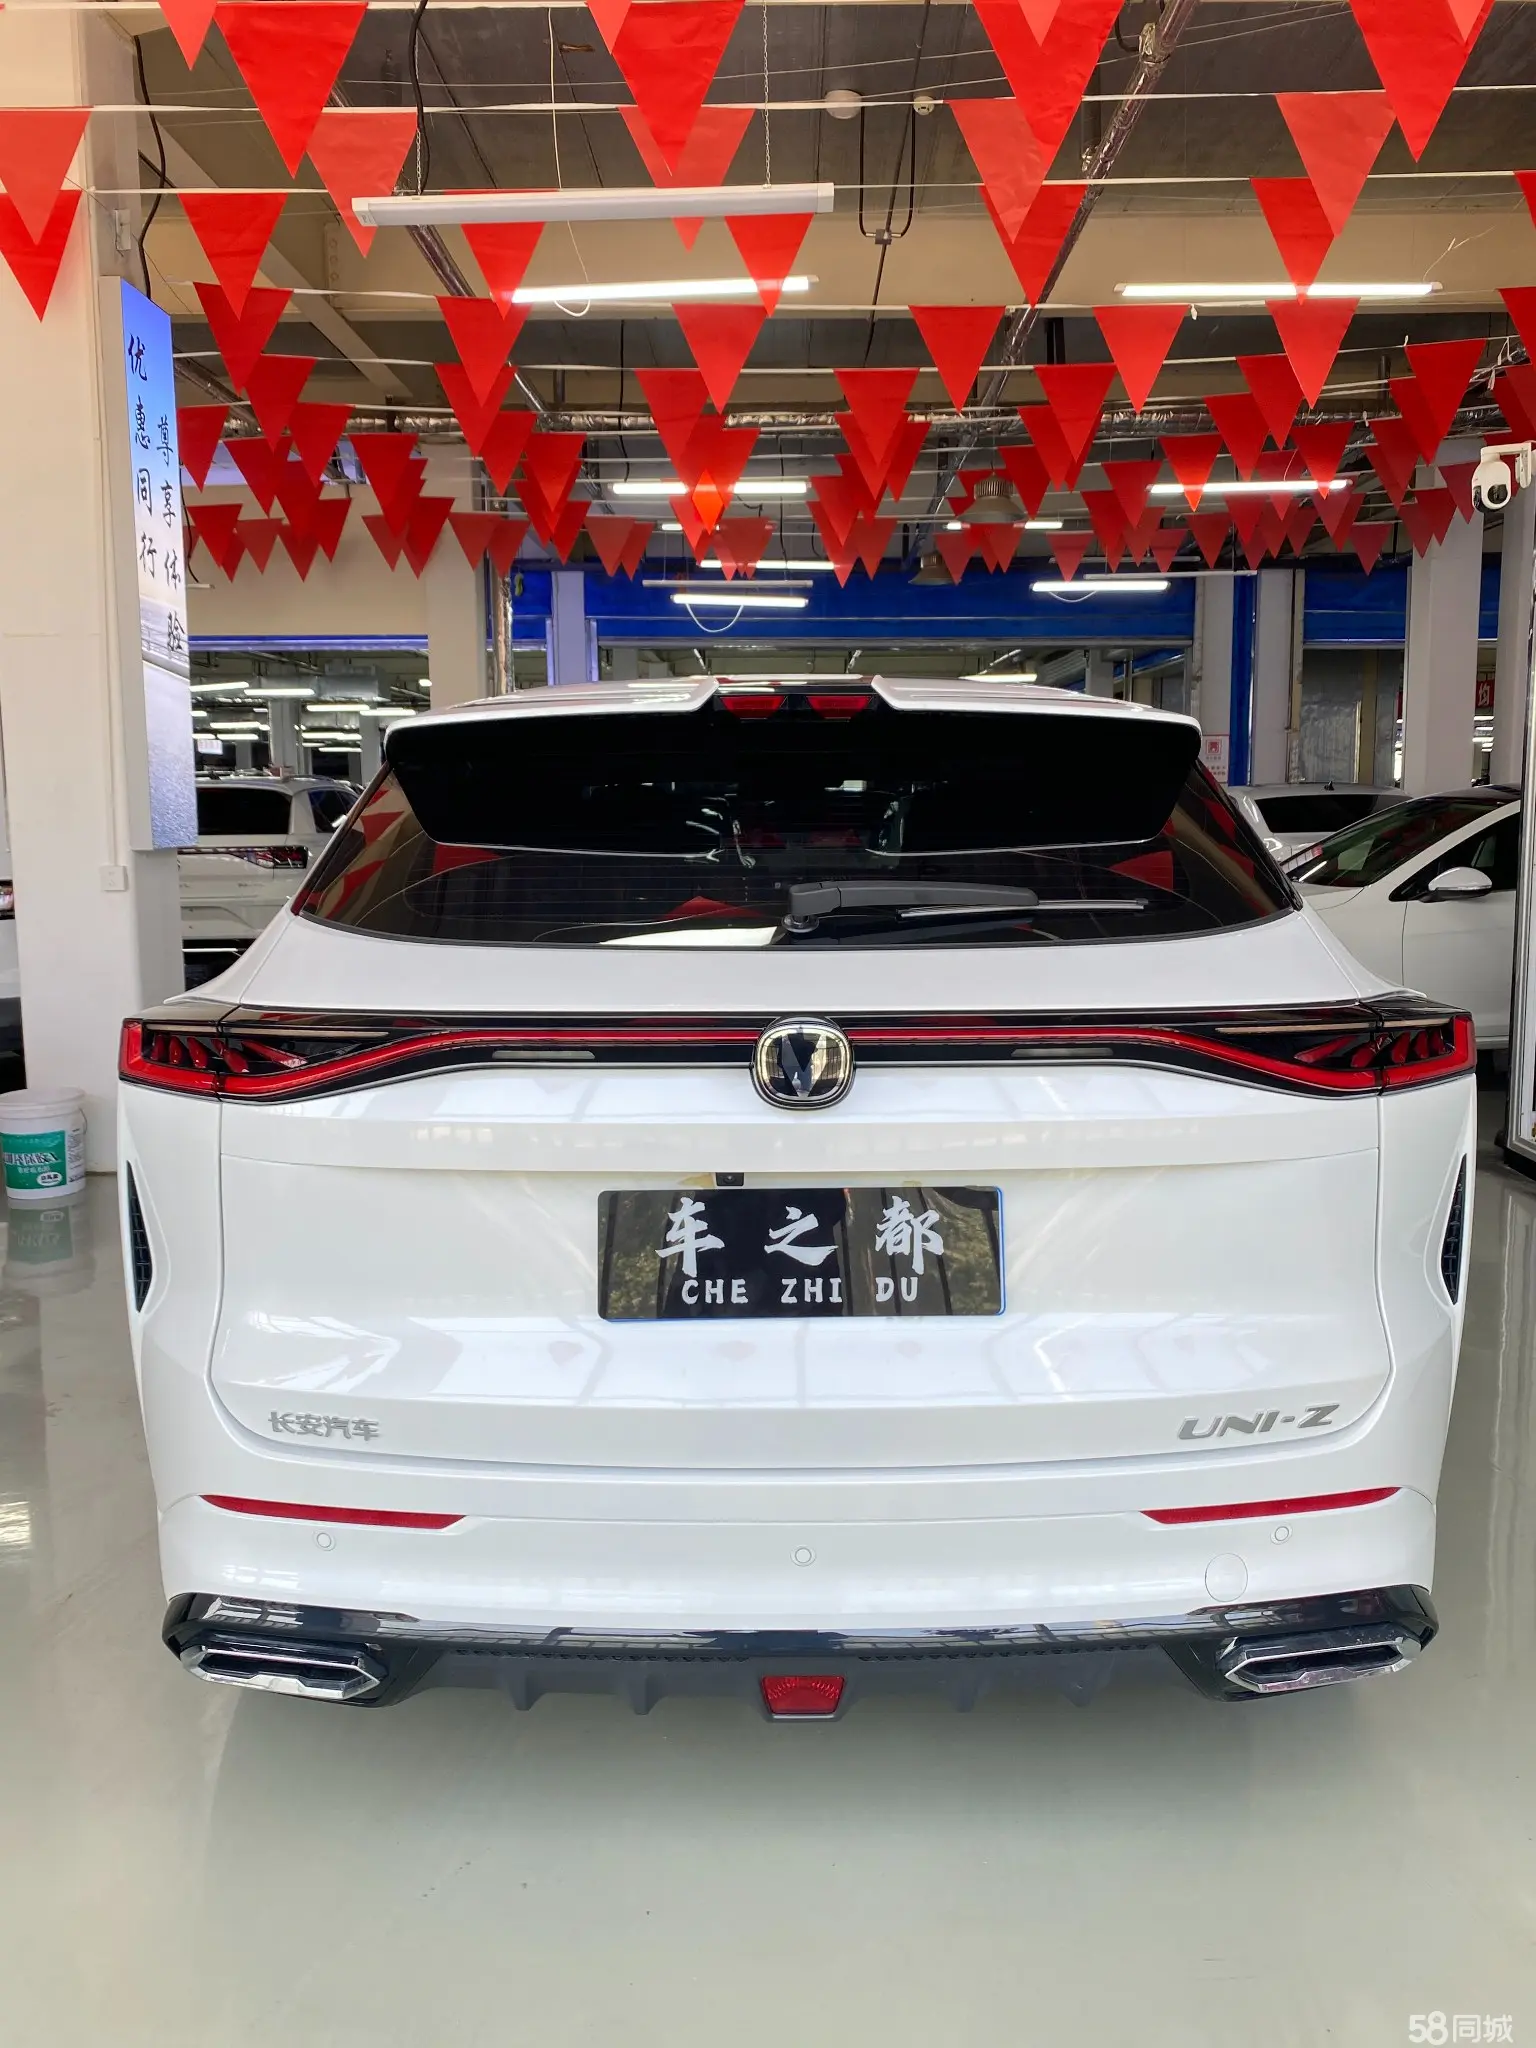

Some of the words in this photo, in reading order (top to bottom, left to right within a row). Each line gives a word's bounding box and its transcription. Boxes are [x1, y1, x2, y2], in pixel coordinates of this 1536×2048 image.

[128, 333, 157, 579] 优惠同行
[157, 414, 186, 651] 尊享体验
[655, 1196, 944, 1278] 车之都
[681, 1278, 749, 1304] CHE
[780, 1277, 843, 1304] ZHI
[876, 1276, 919, 1302] DU
[268, 1411, 379, 1441] 长安汽车
[1178, 1402, 1340, 1440] UNI-Z
